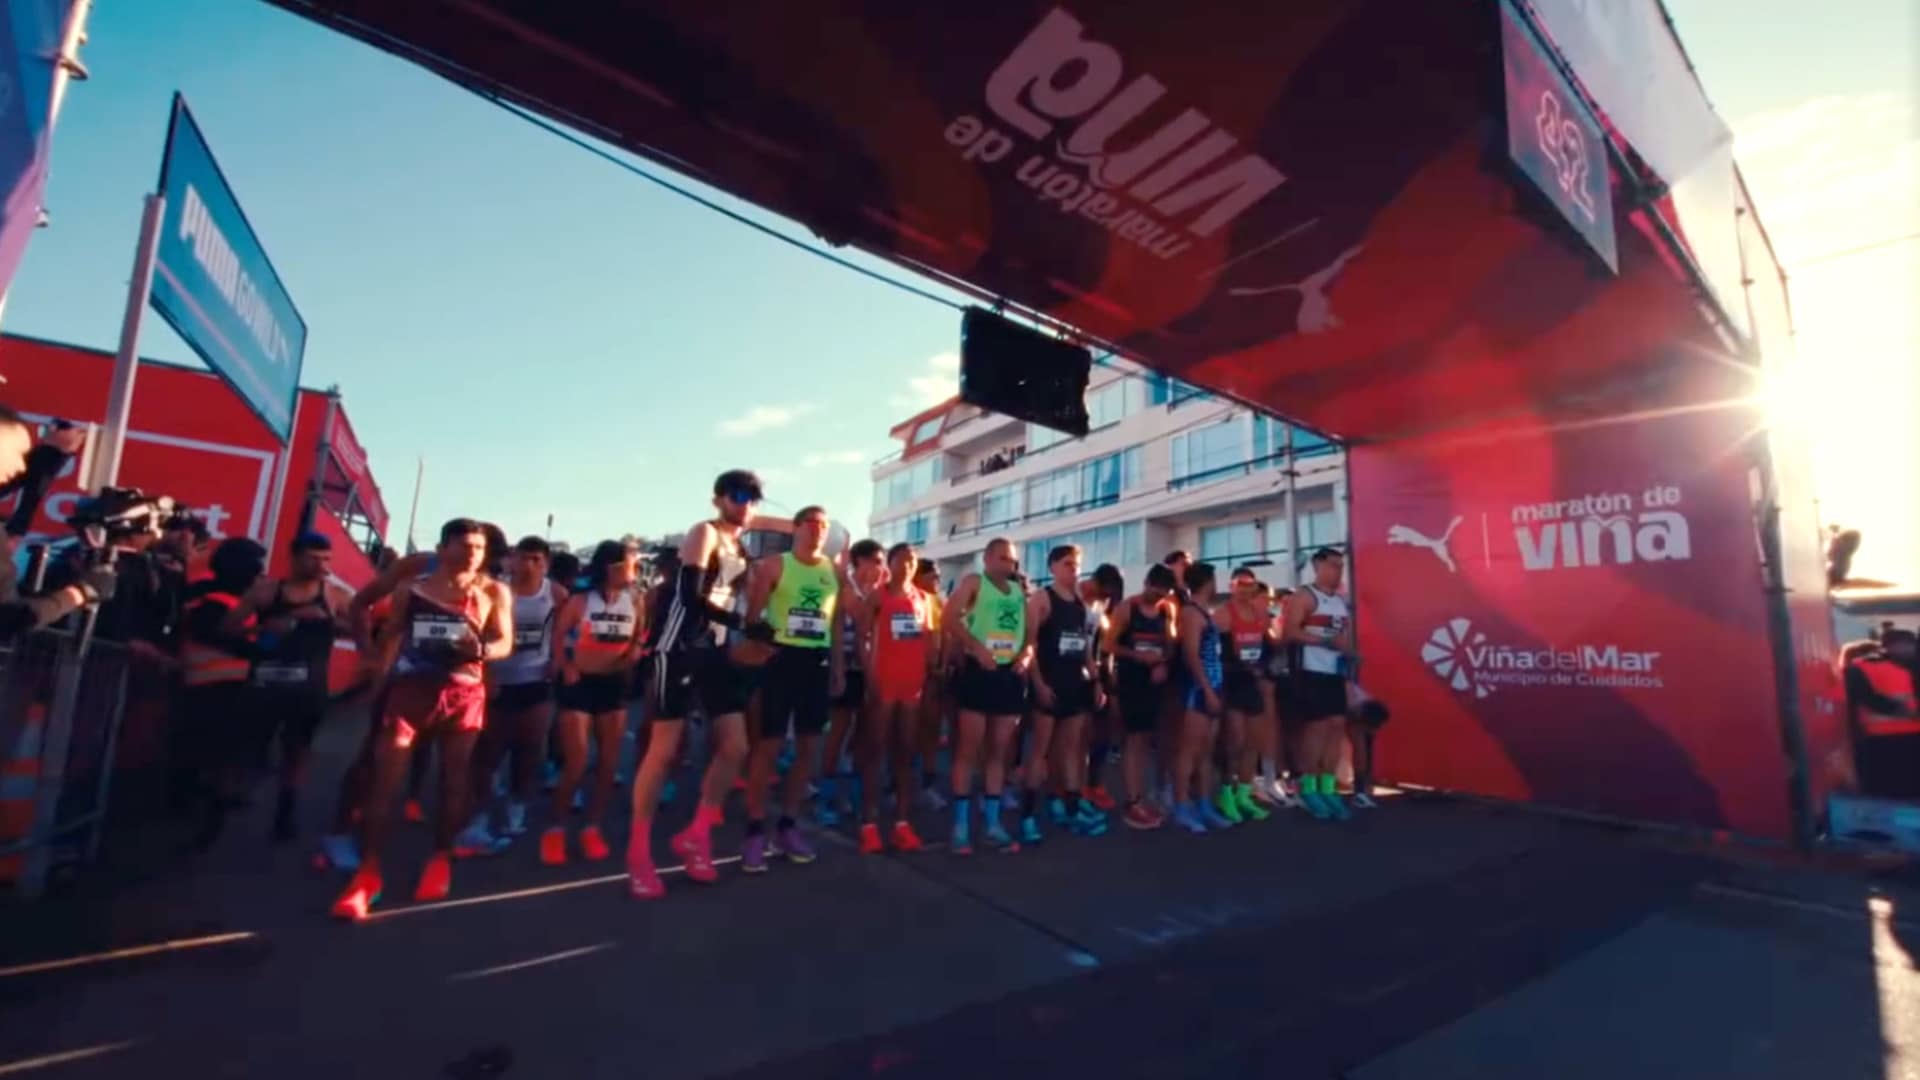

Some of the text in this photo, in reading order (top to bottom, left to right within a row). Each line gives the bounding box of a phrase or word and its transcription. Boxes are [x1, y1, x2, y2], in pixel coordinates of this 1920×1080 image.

[943, 113, 1193, 260] maratón de
[1535, 89, 1595, 224] 42
[179, 182, 241, 306] PUMA
[1511, 485, 1681, 523] maratón de
[1515, 510, 1692, 571] viña
[1474, 670, 1665, 688] Municipio de Cuidados
